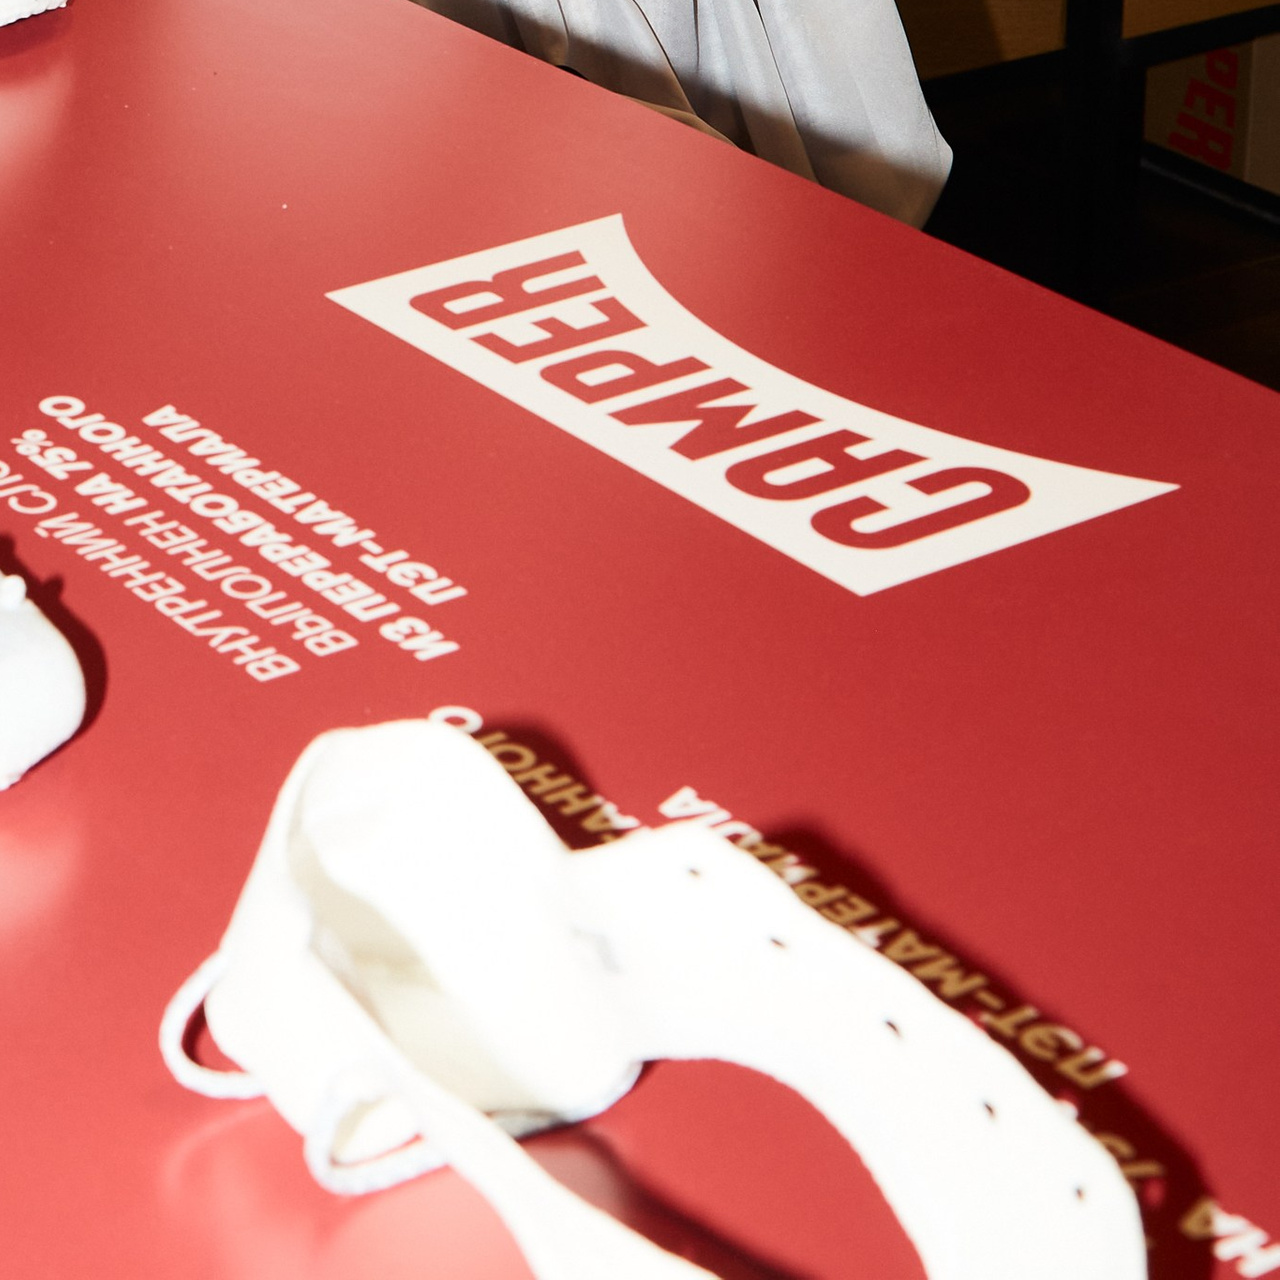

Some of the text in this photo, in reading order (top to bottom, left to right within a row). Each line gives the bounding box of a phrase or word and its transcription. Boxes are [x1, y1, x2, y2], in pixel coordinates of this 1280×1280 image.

[141, 403, 468, 606] ПЭТ-МАТЕРИАЛА
[408, 249, 1031, 550] CAMPER
[10, 427, 360, 657] ВЫПОЛНЕН НА 75%
[35, 511, 301, 683] ВНУТРЕННИЙ
[38, 394, 461, 662] ИЗ ПЕРЕРАБОТАННОГО
